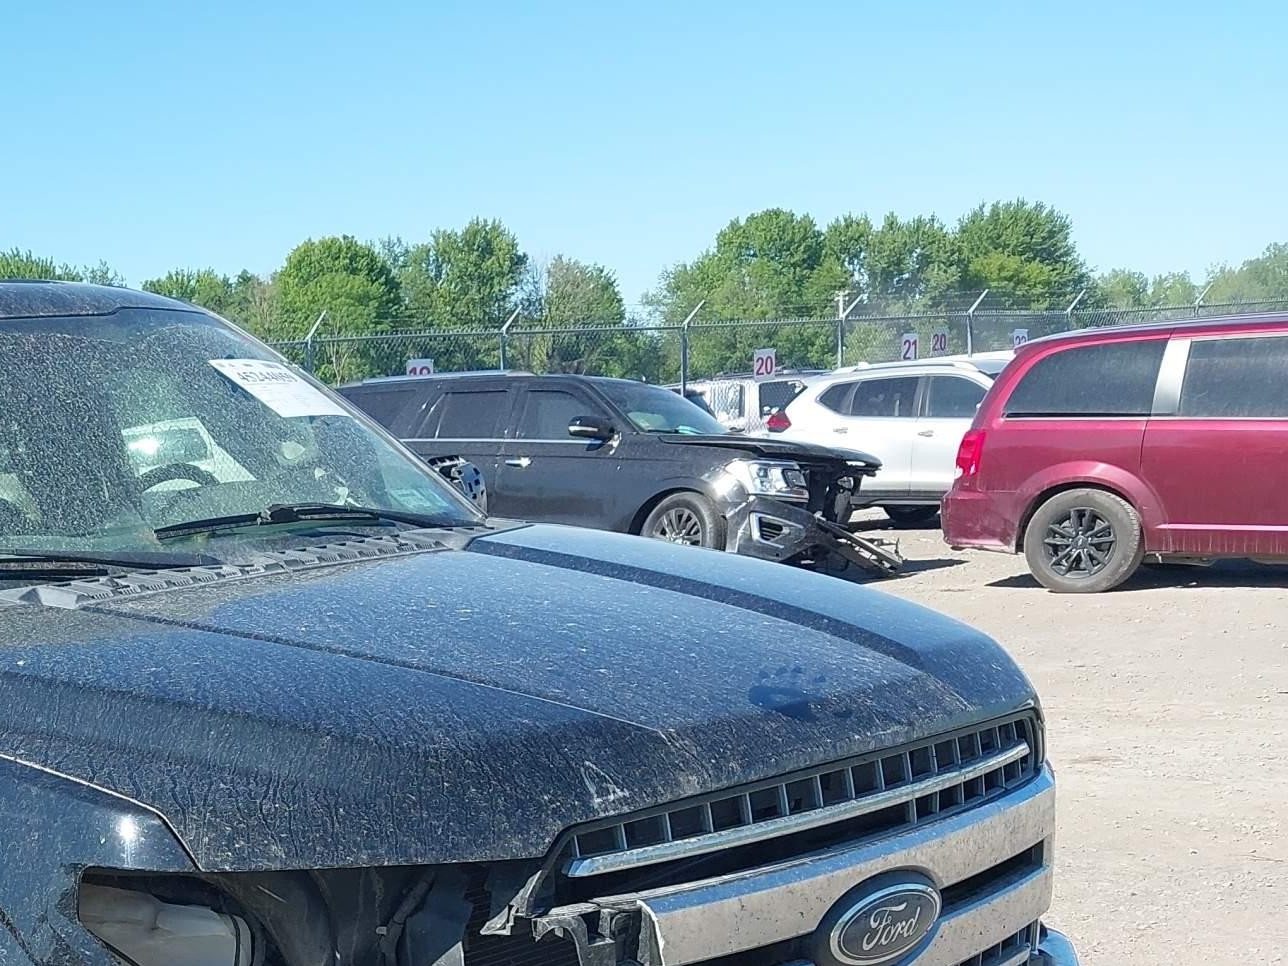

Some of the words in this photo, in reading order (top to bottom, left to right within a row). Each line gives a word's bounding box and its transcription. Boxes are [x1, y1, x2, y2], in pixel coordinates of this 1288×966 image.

[902, 339, 918, 360] 21
[932, 333, 947, 351] 20
[755, 355, 774, 376] 20
[862, 901, 921, 951] Ford
